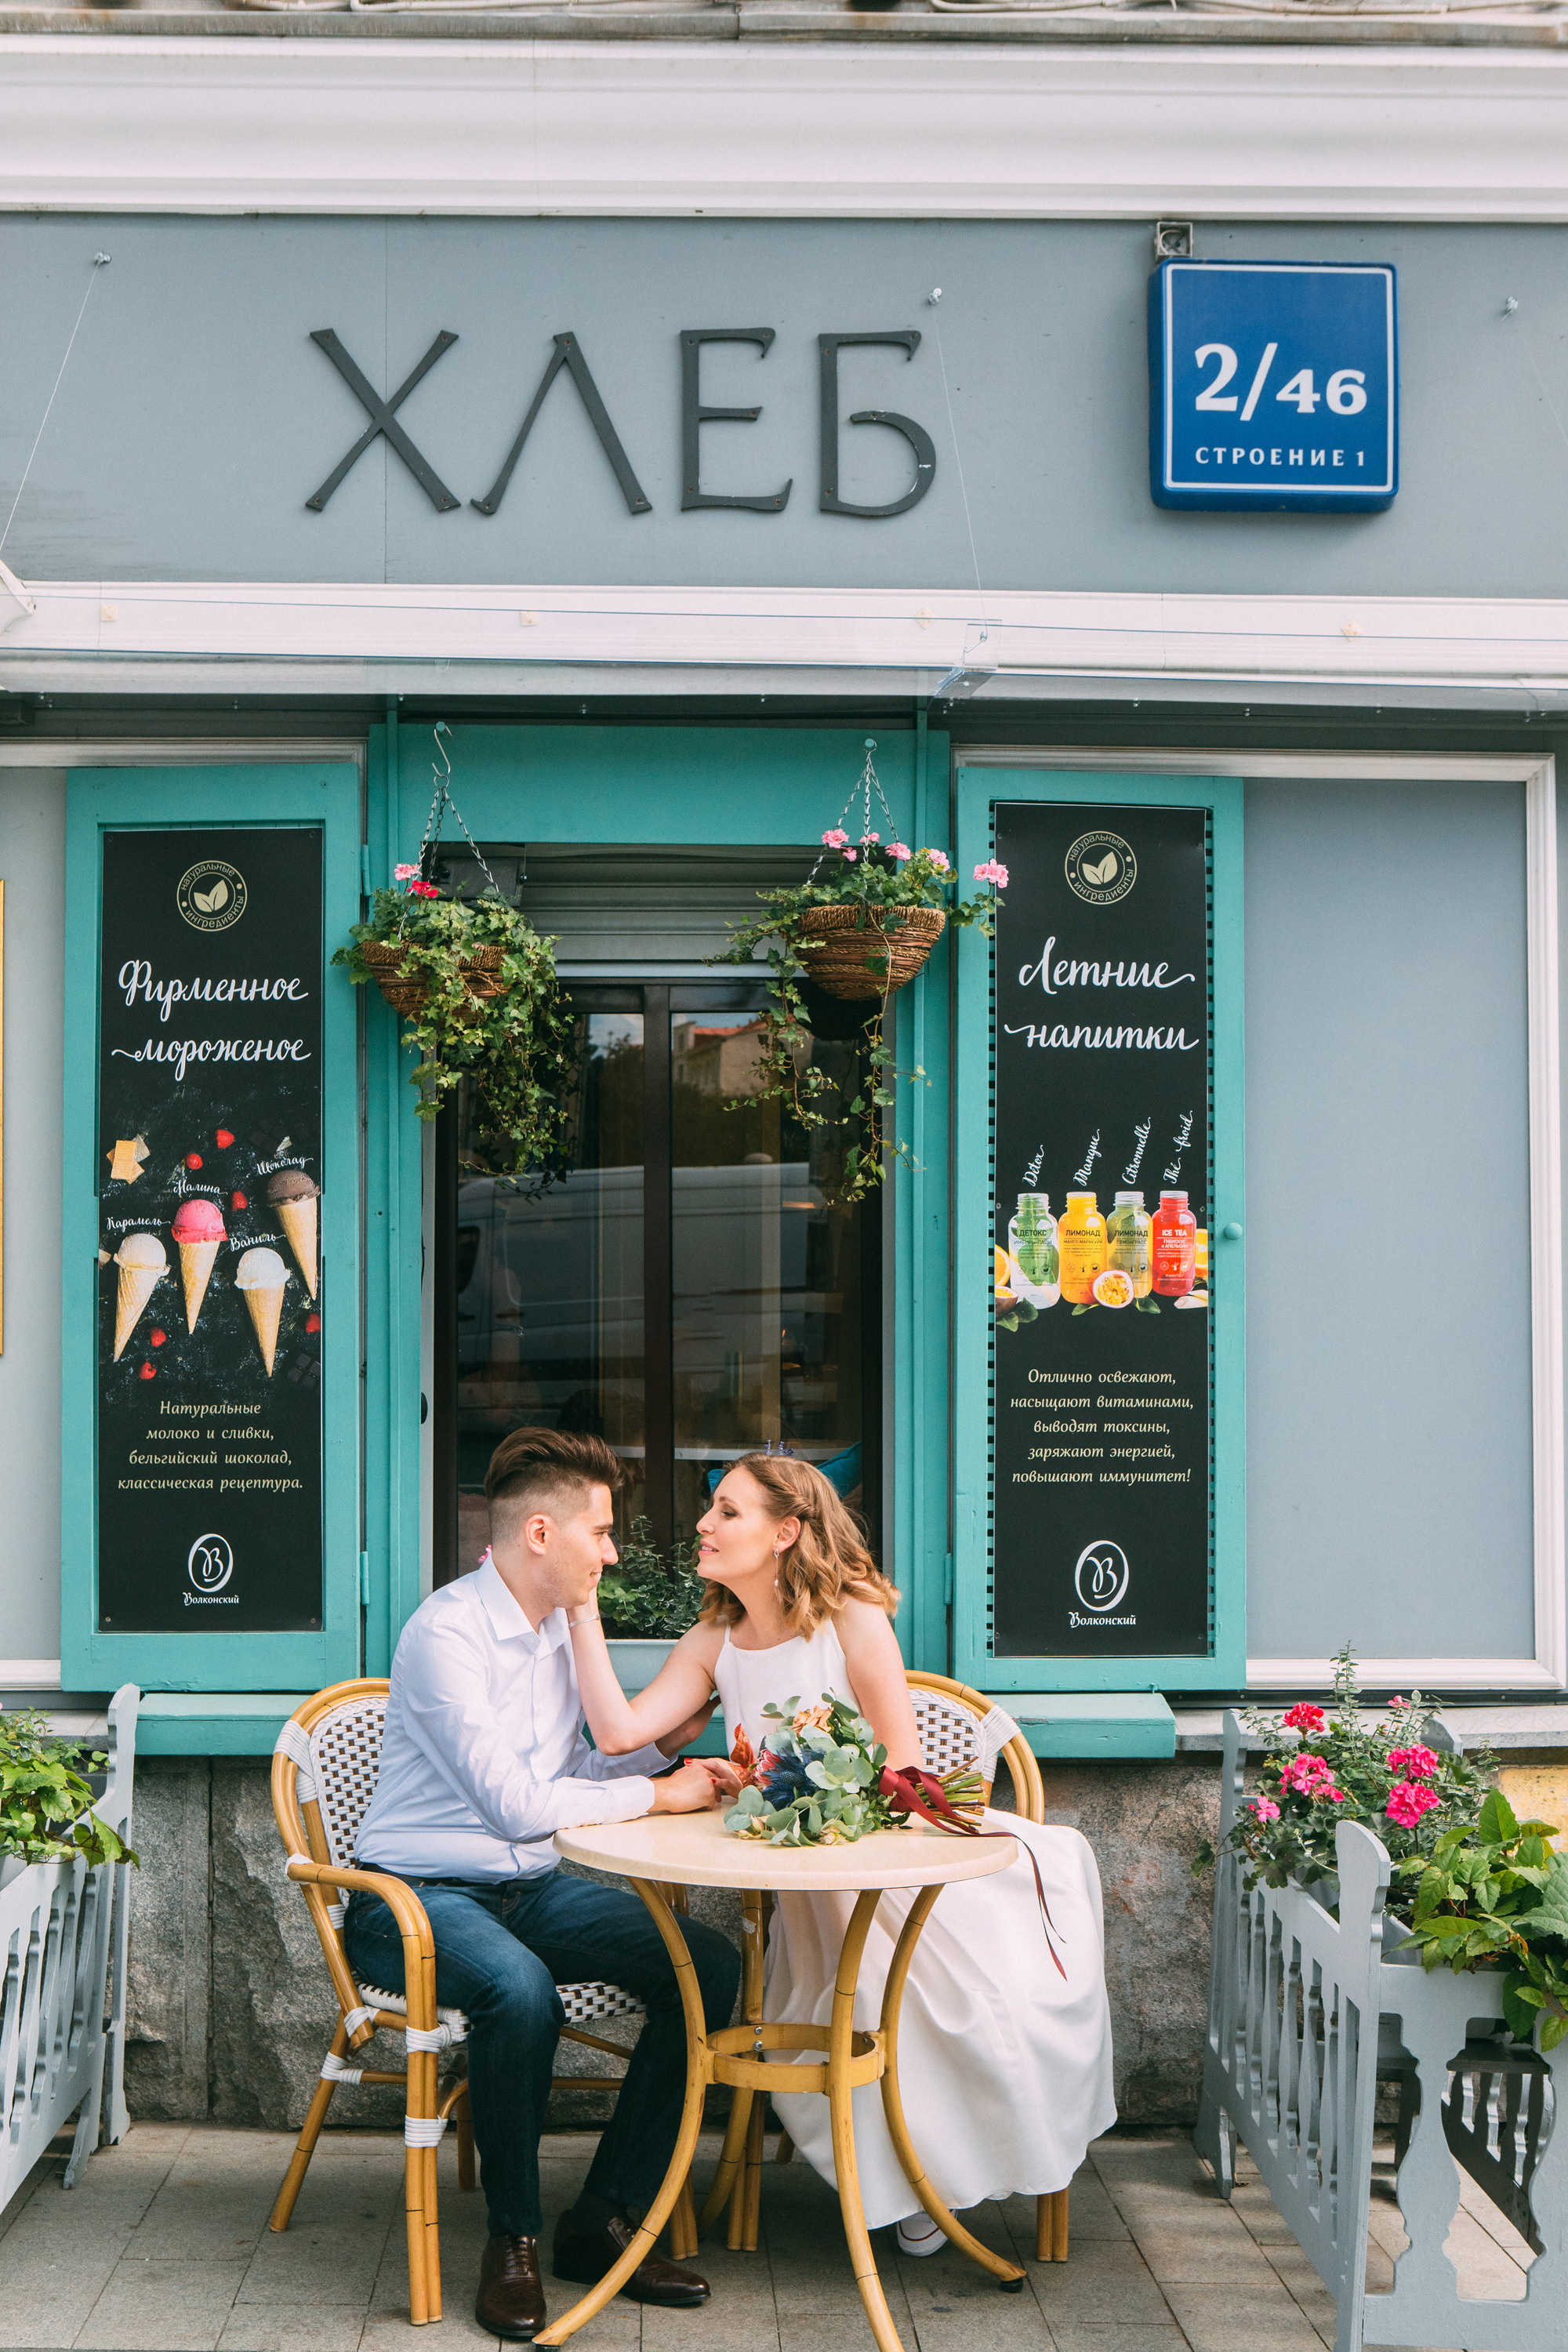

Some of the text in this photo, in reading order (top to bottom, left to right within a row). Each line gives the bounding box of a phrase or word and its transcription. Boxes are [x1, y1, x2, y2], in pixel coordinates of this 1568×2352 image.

[1195, 342, 1367, 421] 2/46
[305, 327, 936, 516] ХЛЕБ
[1195, 447, 1364, 466] СТРОЕНИЕ 1
[1069, 833, 1125, 861] натуральные
[180, 863, 235, 891] натуральные
[1073, 869, 1134, 902] ингредиенты
[185, 895, 244, 929] ингредиенты
[1019, 936, 1196, 994] Летние
[118, 960, 309, 1022] Фирменное
[1004, 1024, 1200, 1050] напитки
[111, 1039, 311, 1081] мороженое
[1122, 1116, 1151, 1185] Citronnelle
[1163, 1110, 1192, 1184] Thé froid
[256, 1156, 314, 1175] Шоколад
[1073, 1129, 1102, 1186] Mangue
[173, 1179, 227, 1196] Малина
[106, 1217, 171, 1231] Карамель
[230, 1234, 286, 1252] Ваниль
[1028, 1369, 1177, 1385] Отлично освежают,
[160, 1400, 261, 1418] Натуральные
[1011, 1396, 1193, 1411] насыщают витаминами,
[147, 1426, 274, 1440] молоко и сливки,
[1033, 1419, 1170, 1435] выводят токсины,
[129, 1450, 292, 1466] бельгийский шоколад,
[1028, 1445, 1175, 1461] заряжают энергией,
[118, 1478, 303, 1493] классическая рецептура.
[1012, 1468, 1191, 1486] повышают иммунитет!
[183, 1592, 239, 1606] Волконский
[1068, 1611, 1136, 1628] Волконский
